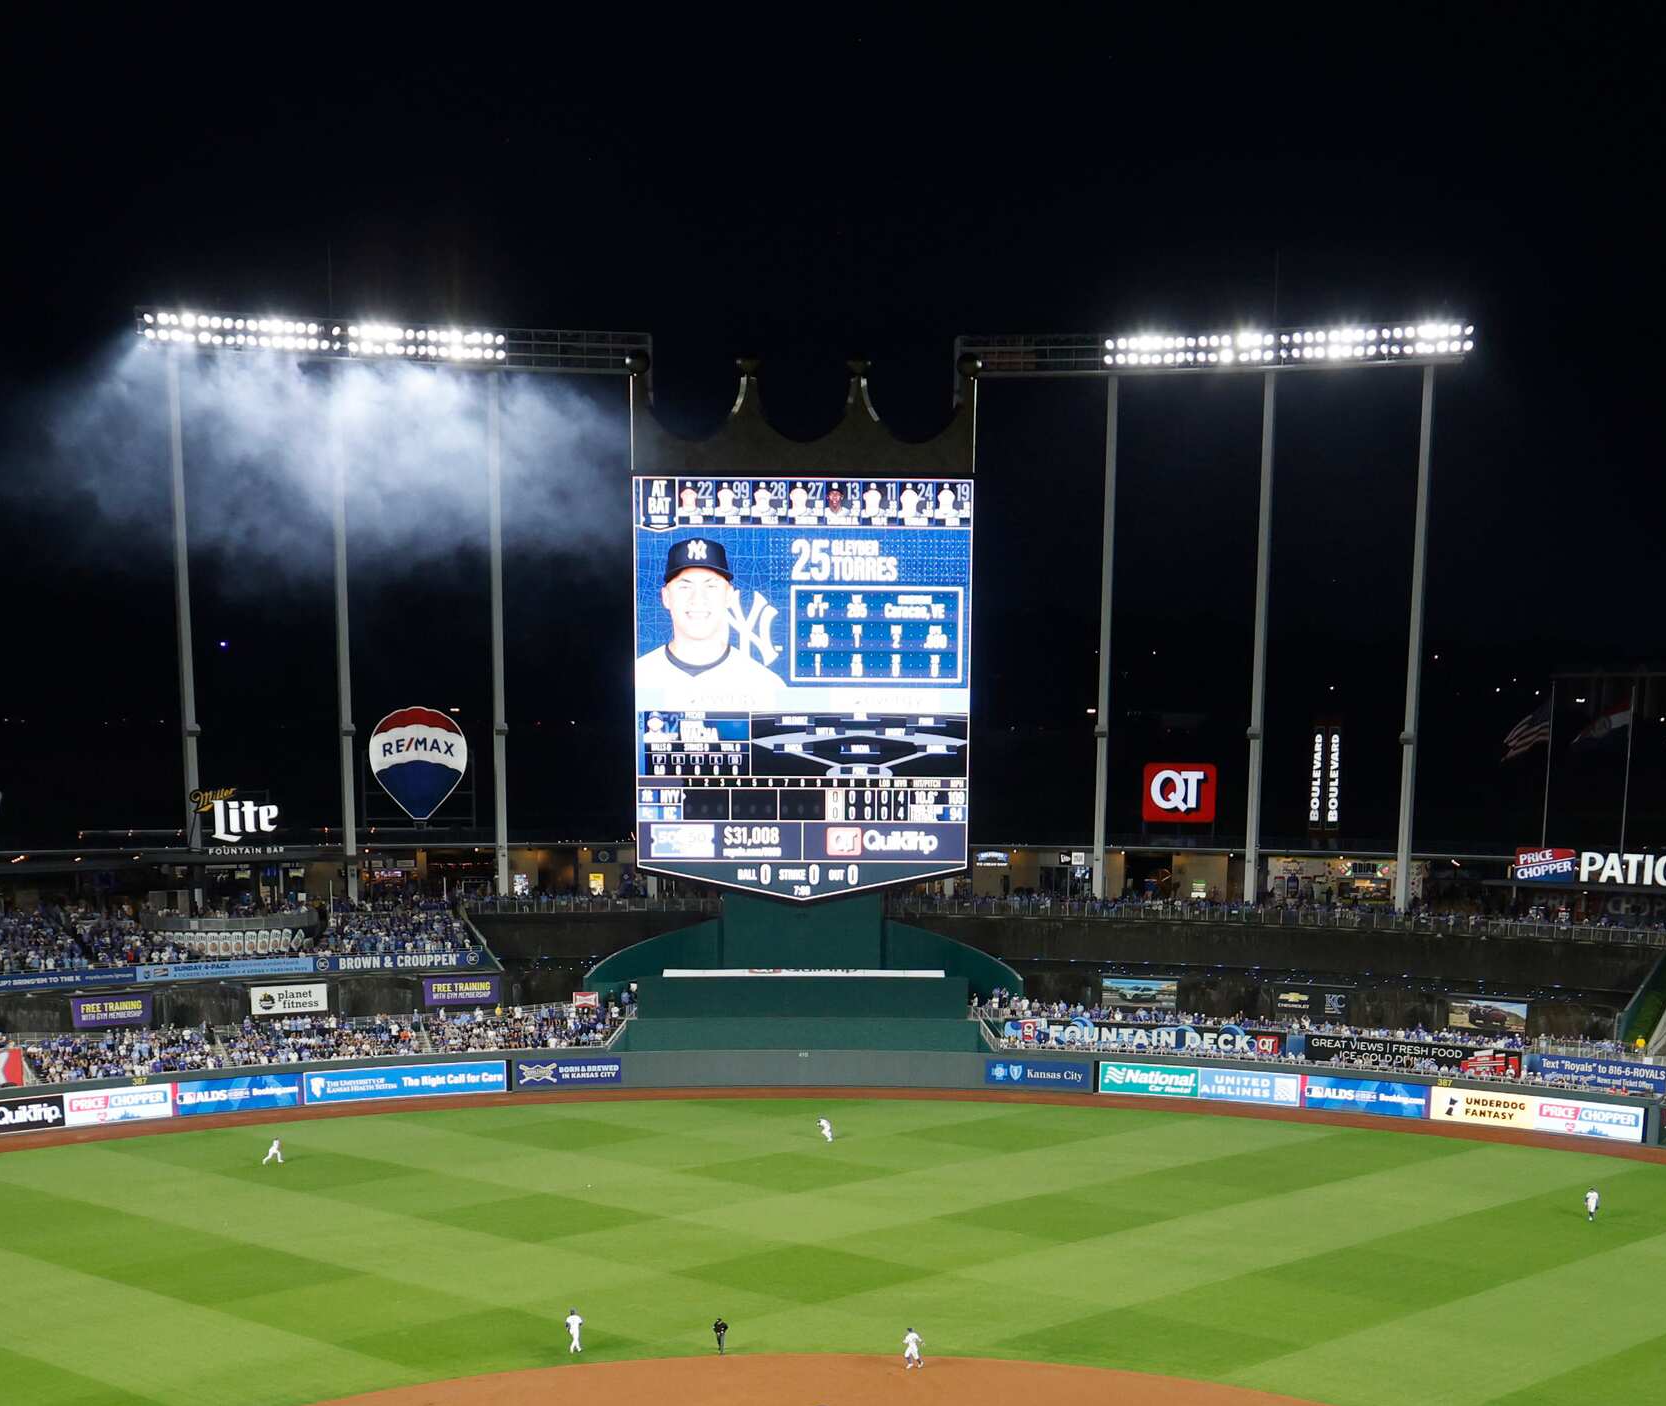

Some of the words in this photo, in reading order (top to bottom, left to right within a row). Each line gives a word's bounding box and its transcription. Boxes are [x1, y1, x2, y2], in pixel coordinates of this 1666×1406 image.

[652, 480, 667, 496] AT
[697, 482, 713, 499] 22
[733, 482, 749, 499] 99
[770, 482, 786, 499] 28
[808, 482, 823, 499] 27
[846, 483, 860, 500] 13
[886, 483, 897, 500] 11
[918, 483, 933, 501] 24
[956, 484, 970, 501] 19
[648, 497, 671, 514] BAT
[791, 539, 830, 581] 25
[832, 556, 898, 581] TORRES
[383, 737, 454, 757] RE/MAX
[1309, 734, 1323, 822] BOULEVARD
[1327, 734, 1340, 822] BOULEVARD
[660, 789, 680, 803] NYY
[1150, 770, 1205, 812] QT
[191, 787, 237, 813] Miller
[211, 799, 280, 841] Lite
[663, 807, 677, 819] KC
[949, 807, 963, 821] 94
[723, 826, 780, 846] $31,008
[863, 830, 938, 855] QuikTrip
[208, 846, 263, 855] FOUNTAIN
[267, 846, 284, 854] BAR
[1519, 849, 1553, 865] PRICE
[737, 869, 757, 882] BALL
[760, 864, 771, 885] 0
[778, 869, 806, 881] STRIKE
[808, 864, 820, 885] 0
[828, 869, 845, 881] OUT
[847, 864, 859, 885] 0
[1517, 860, 1572, 880] CHOPPER
[339, 957, 380, 969] BROWN
[384, 956, 393, 967] &
[397, 954, 456, 967] CROUPPEN
[278, 989, 312, 1000] planet
[432, 983, 452, 992] FREE
[455, 982, 491, 992] TRAINING
[81, 1003, 101, 1013] FREE
[103, 1000, 141, 1012] TRAINING
[283, 998, 319, 1009] fitness
[109, 1010, 142, 1018] MEMBERSHIP
[1050, 1025, 1176, 1048] FOUNTAIN
[1185, 1033, 1251, 1051] DECK
[1259, 1039, 1275, 1052] QT
[1311, 1038, 1349, 1049] GREAT
[1350, 1041, 1383, 1052] VIEWS
[1393, 1044, 1427, 1055] FRESH
[1432, 1047, 1463, 1058] FOOD
[1027, 1070, 1061, 1081] Kansas
[1064, 1070, 1083, 1083] City
[1542, 1058, 1560, 1069] Text
[1561, 1060, 1597, 1074] "Royals"
[1598, 1064, 1607, 1072] to
[1609, 1065, 1666, 1080] 816-6-ROYALS
[132, 1077, 147, 1085] 387
[402, 1076, 419, 1087] The
[421, 1075, 446, 1088] Right
[447, 1074, 466, 1085] Call
[467, 1073, 480, 1084] for
[481, 1072, 503, 1083] Care
[1215, 1074, 1271, 1087] UNITED
[197, 1090, 227, 1103] ALDS
[1201, 1084, 1271, 1098] AIRLINES
[1325, 1089, 1356, 1099] ALDS
[71, 1096, 109, 1110] PRICE
[110, 1091, 168, 1107] CHOPPER
[1466, 1097, 1525, 1111] UNDERDOG
[1465, 1109, 1514, 1120] FANTASY
[1541, 1105, 1578, 1117] PRICE
[1581, 1109, 1638, 1125] CHOPPER
